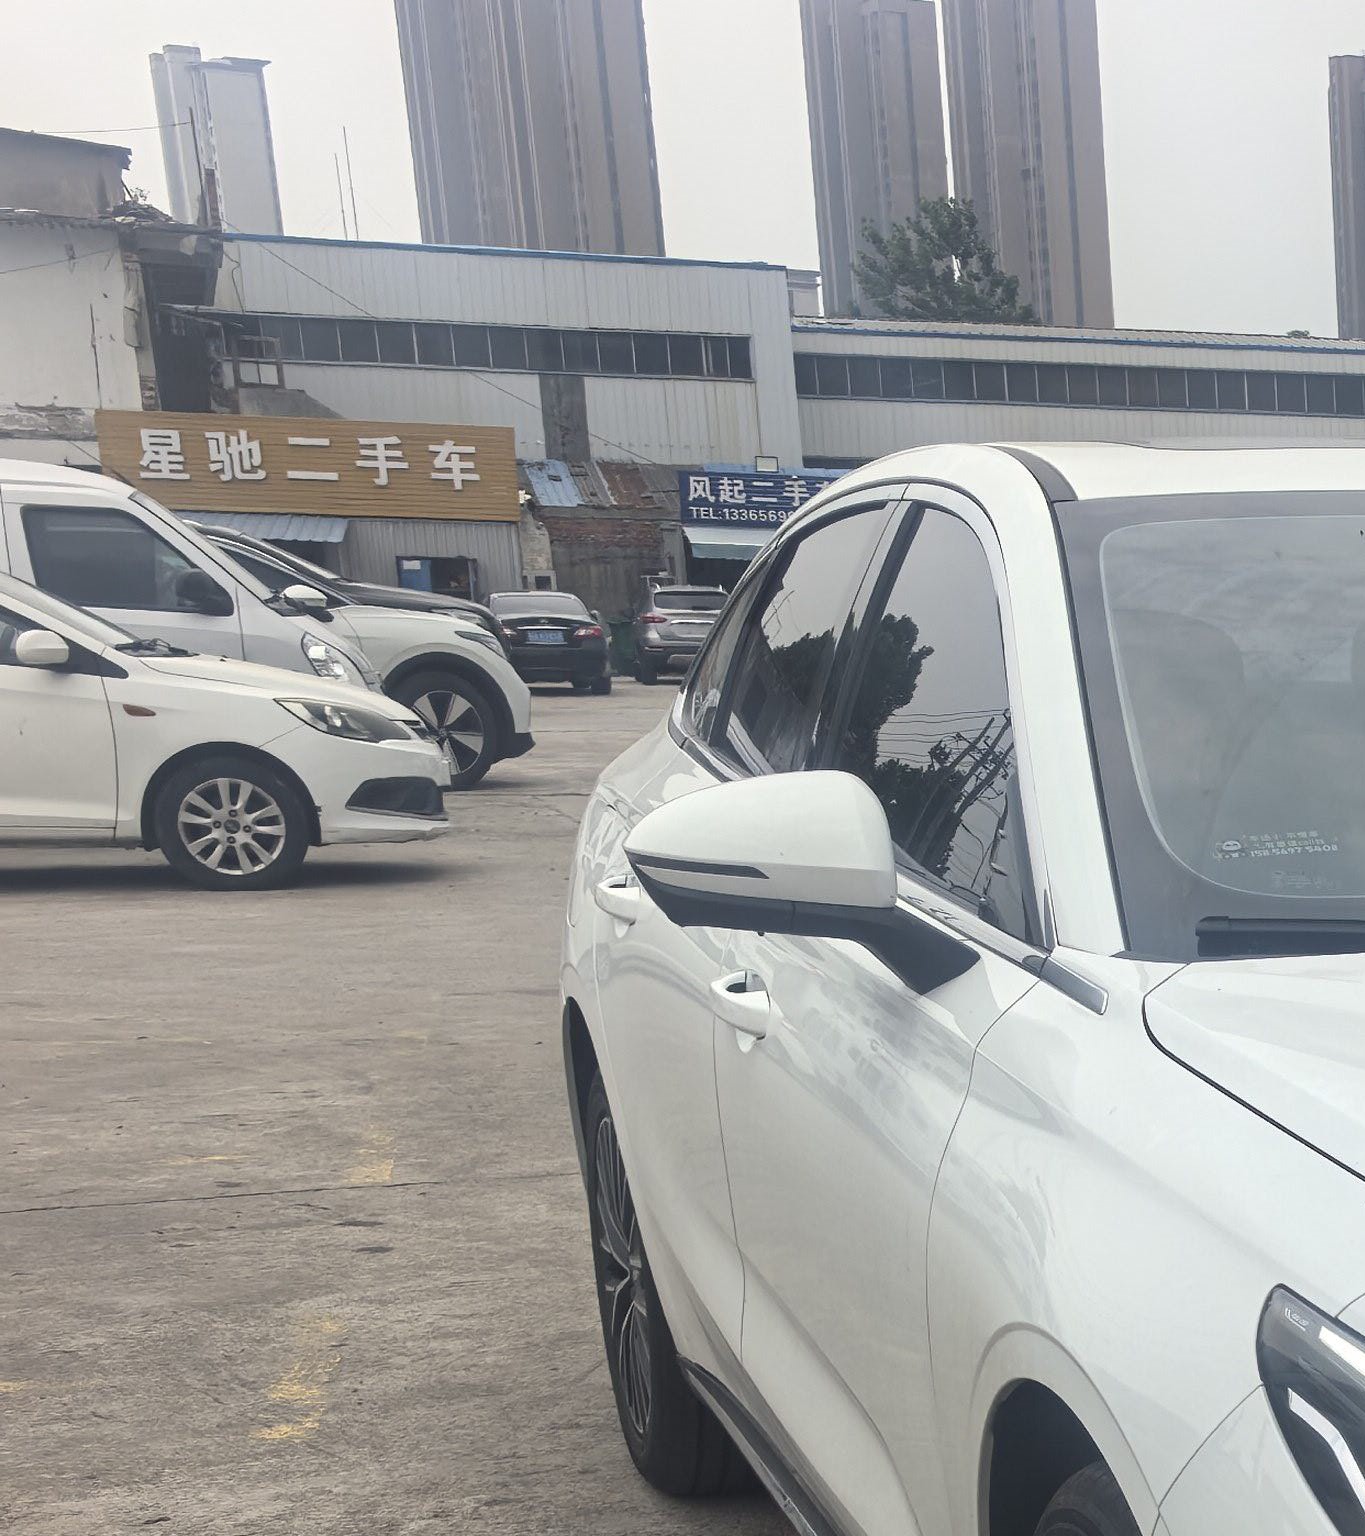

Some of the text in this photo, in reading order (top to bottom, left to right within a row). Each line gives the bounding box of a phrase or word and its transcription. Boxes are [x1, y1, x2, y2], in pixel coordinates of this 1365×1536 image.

[139, 428, 481, 490] 星驰二手车
